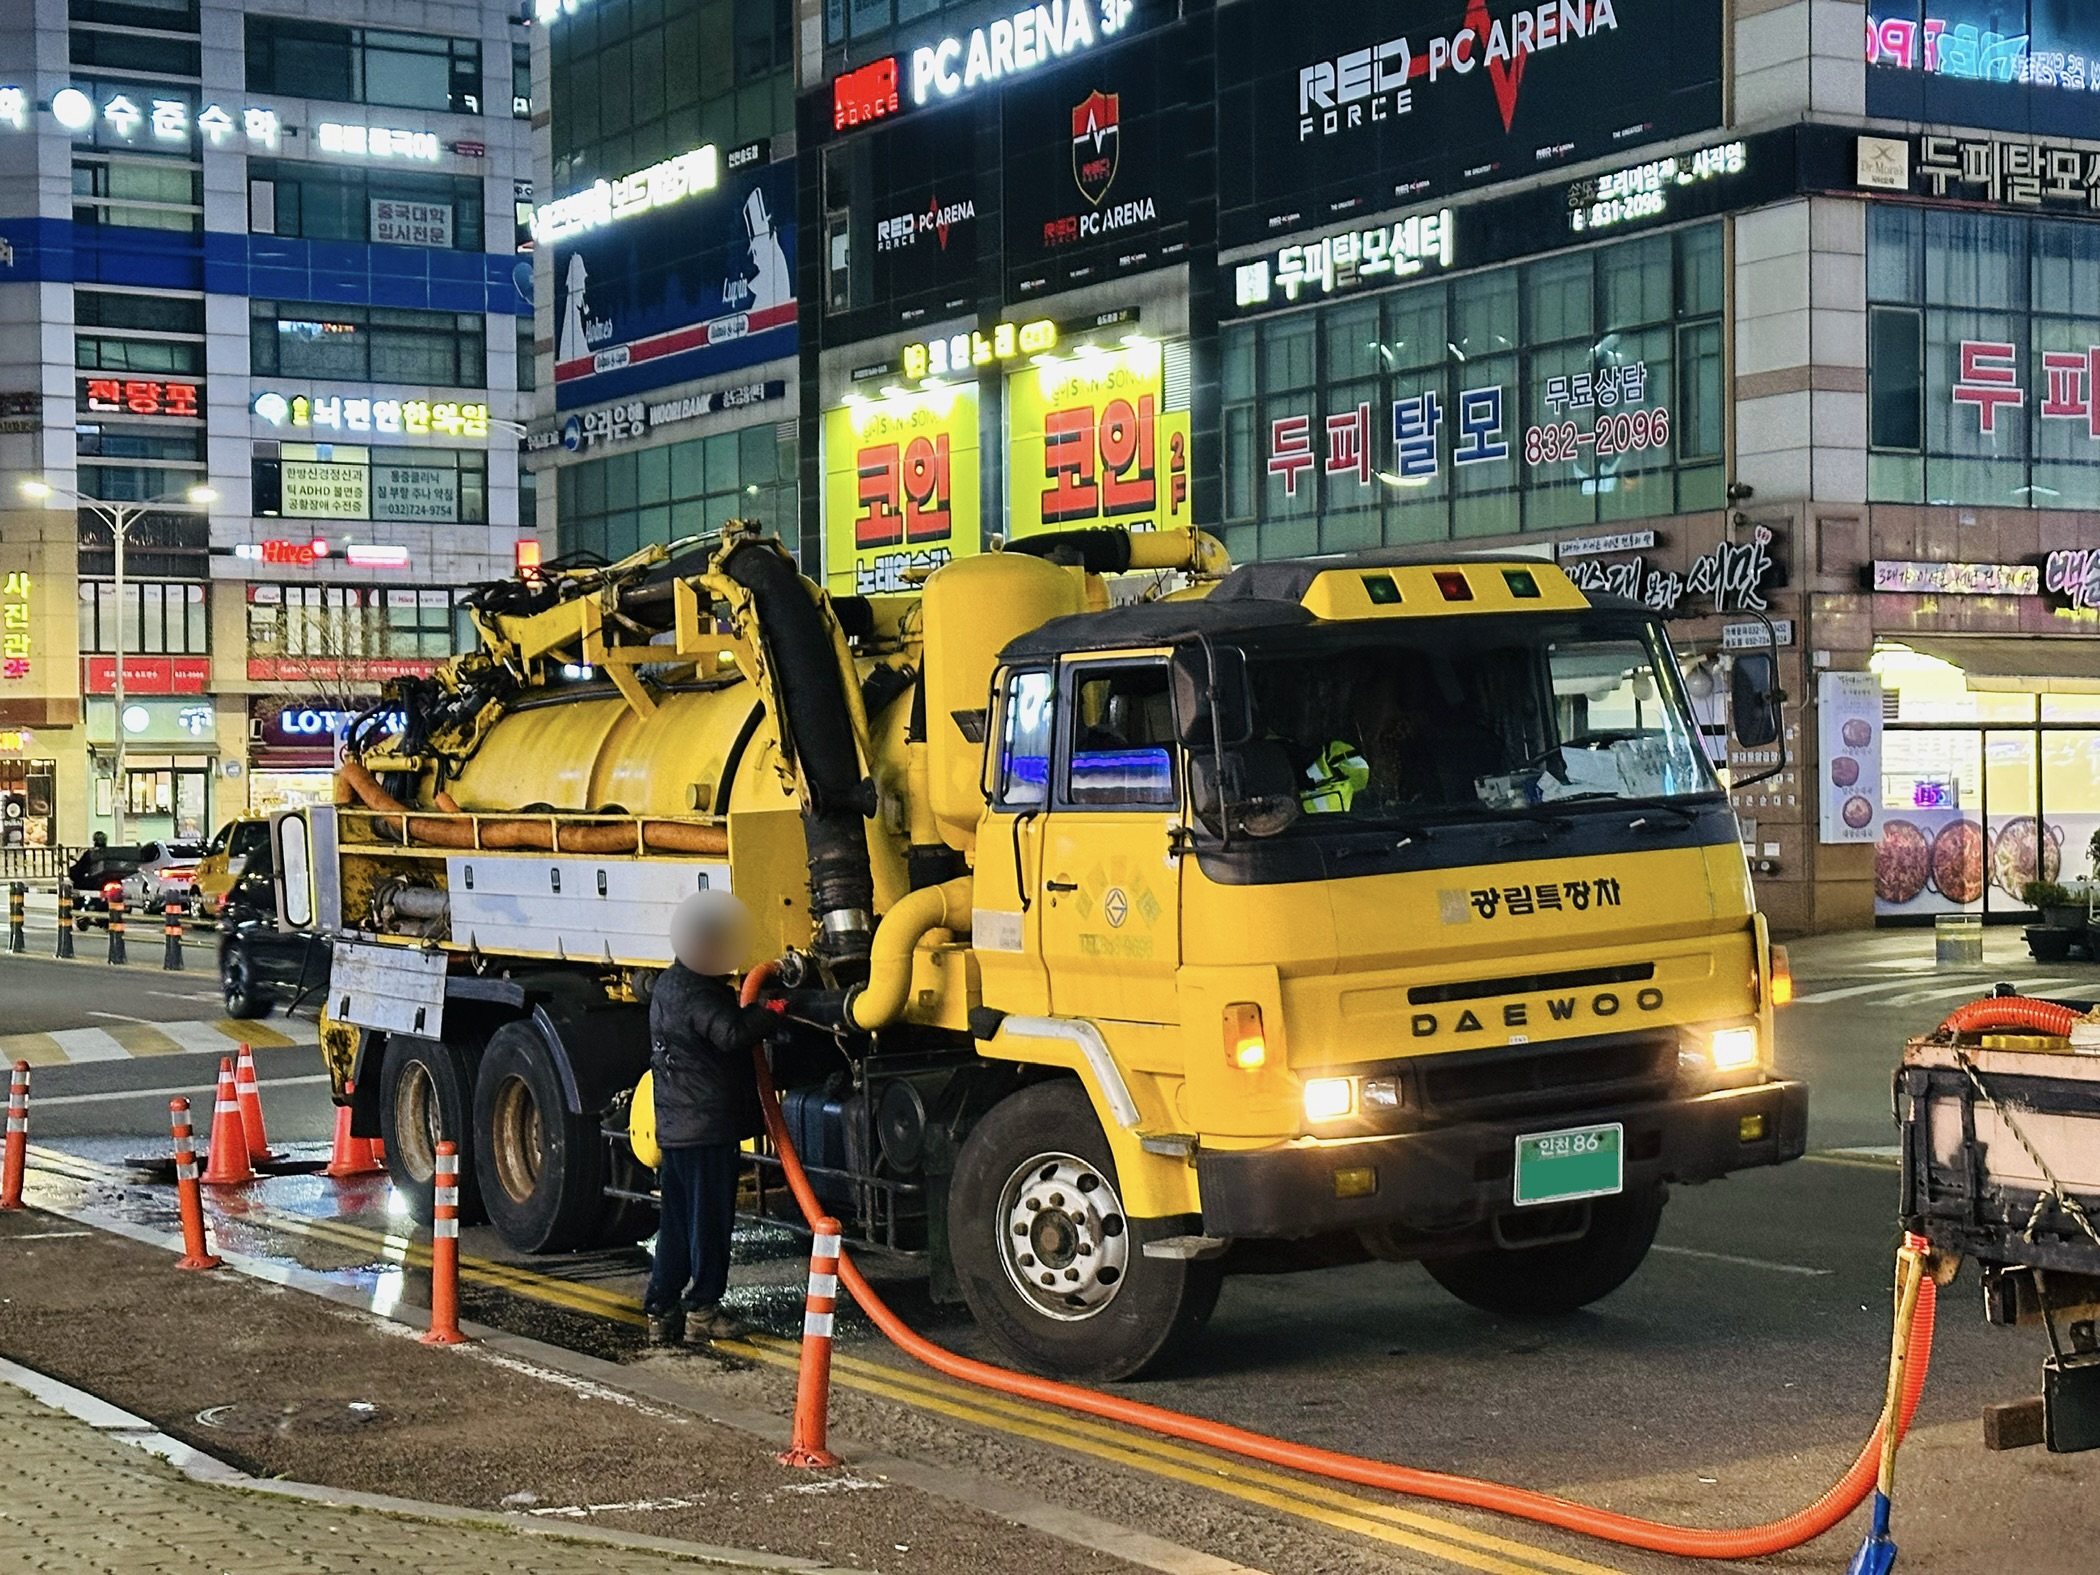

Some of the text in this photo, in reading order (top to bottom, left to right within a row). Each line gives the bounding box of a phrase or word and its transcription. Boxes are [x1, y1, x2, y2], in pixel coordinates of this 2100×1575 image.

[912, 37, 961, 104] PC
[964, 0, 1094, 86] ARENA
[1300, 0, 1618, 115] RED PC ARENA
[104, 94, 276, 147] 수준수학
[836, 92, 899, 130] FORCE
[1300, 88, 1412, 141] FORCE
[377, 202, 446, 224] 중국대학
[378, 222, 446, 244] 입시전문
[878, 200, 975, 241] RED PC ARENA
[1080, 212, 1100, 237] PC
[1102, 197, 1156, 232] ARENA
[878, 233, 915, 252] FORCE
[1275, 208, 1454, 301] 두피탈모센터
[87, 379, 198, 415] 전당포
[1545, 360, 1647, 415] 무료상담
[582, 402, 645, 445] 우리은행
[649, 393, 712, 426] WOORI BANK
[1525, 406, 1669, 466] 832-2096
[287, 467, 363, 483] 한방신경정신과
[1042, 392, 1156, 524] 코인
[288, 498, 362, 513] 공황장애 수전증
[300, 487, 331, 497] ADHD
[333, 487, 364, 498] 불면증
[388, 505, 453, 517] 032)724-9754
[855, 432, 952, 550] 코인
[264, 541, 313, 562] Hive
[3, 571, 32, 659] 사진관
[1470, 877, 1621, 919] 광림특장차
[1411, 987, 1664, 1037] DAEWOO
[1539, 1133, 1598, 1156] 인천 86
